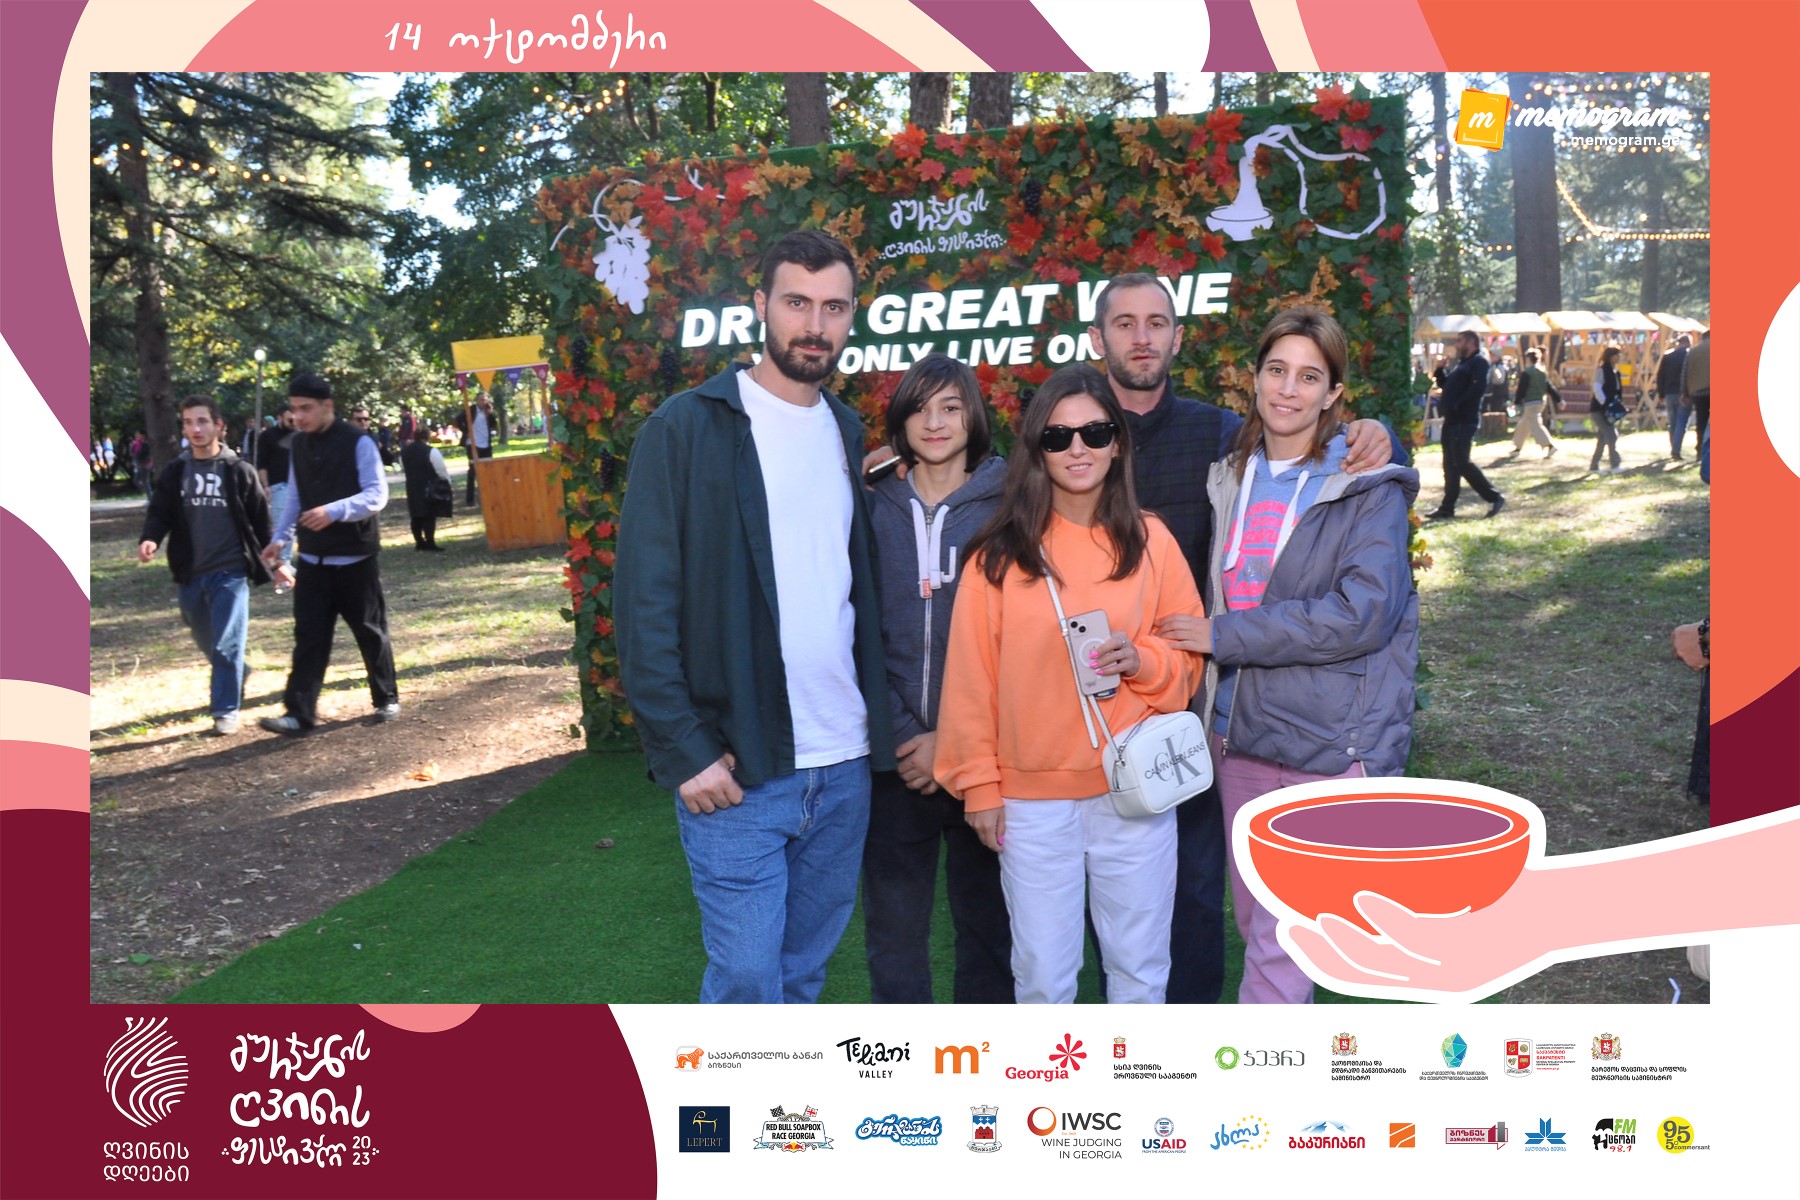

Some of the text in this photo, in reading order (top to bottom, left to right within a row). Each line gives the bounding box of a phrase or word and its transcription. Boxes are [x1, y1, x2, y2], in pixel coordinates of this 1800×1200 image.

[867, 283, 1060, 335] GREAT
[837, 342, 934, 374] ONLY
[947, 335, 1034, 367] LIVE
